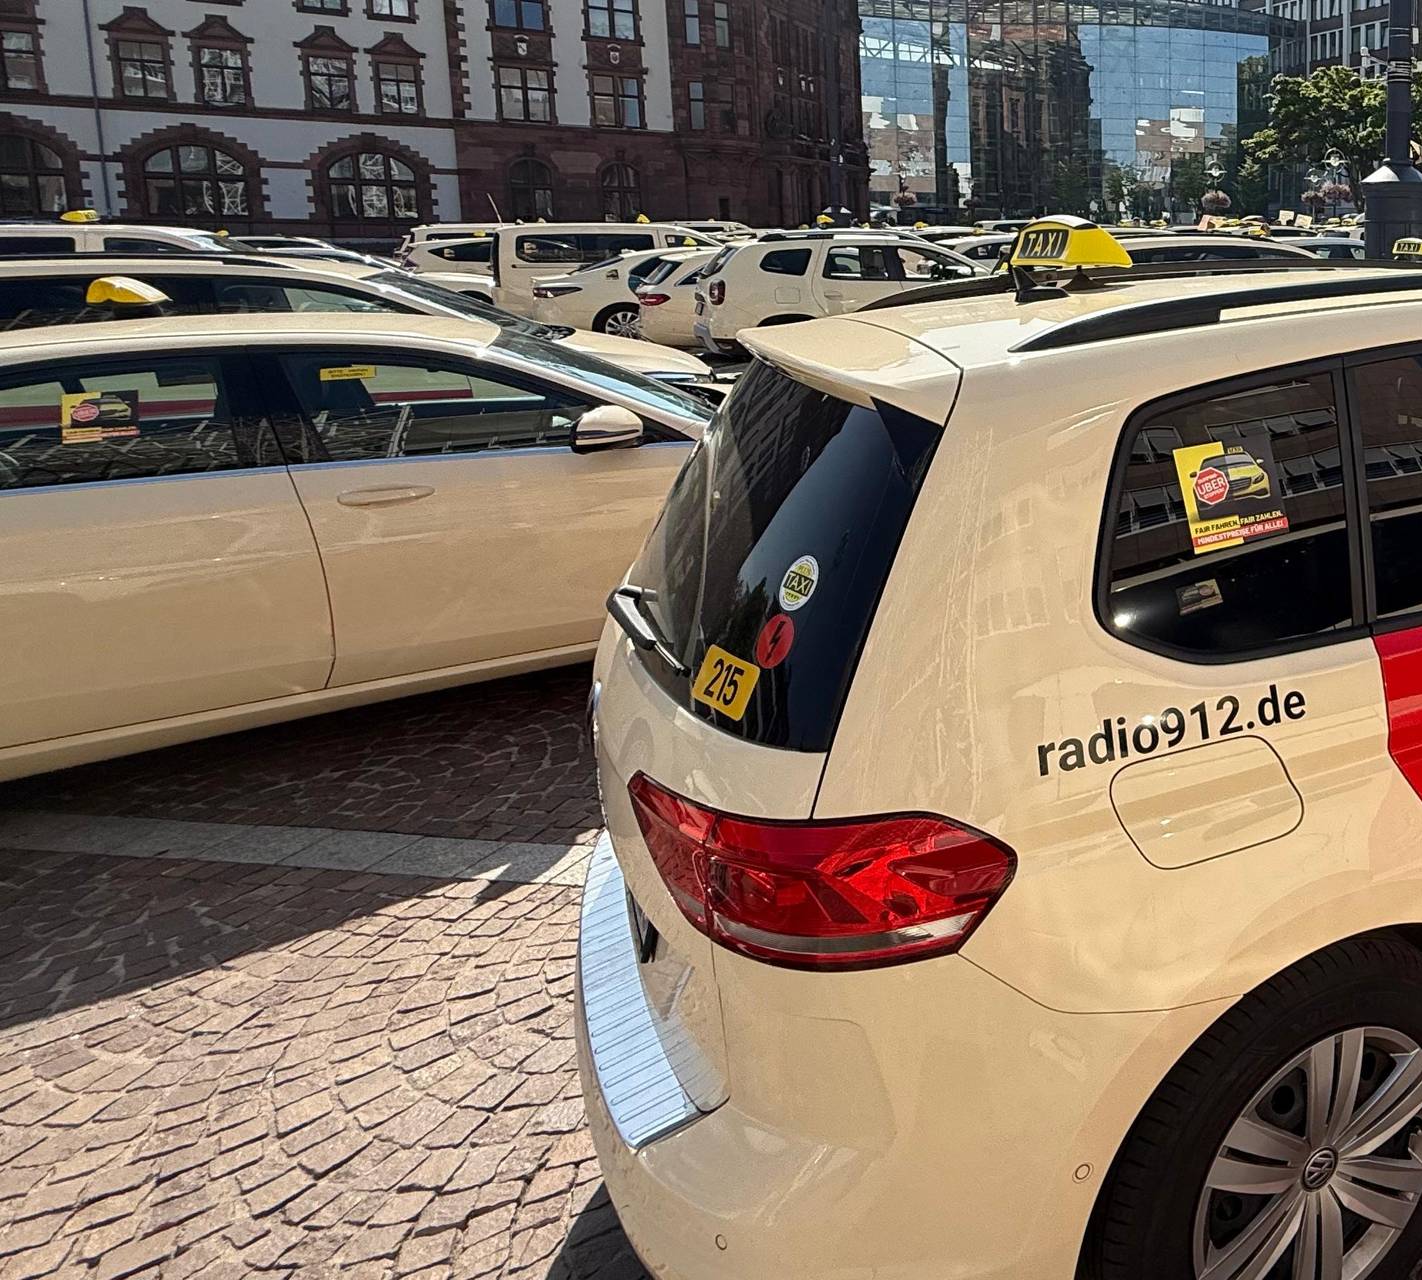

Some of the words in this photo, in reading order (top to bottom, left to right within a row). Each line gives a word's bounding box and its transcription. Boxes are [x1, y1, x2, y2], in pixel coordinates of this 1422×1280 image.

[1025, 232, 1063, 257] TAXI
[1400, 243, 1418, 252] TAXI
[1197, 477, 1227, 495] UBER
[1194, 525, 1211, 535] FAIR
[1211, 519, 1240, 532] FAHREN.
[1240, 515, 1255, 525] FAIR
[1255, 510, 1284, 522] ZAHLEN.
[1197, 528, 1250, 546] MINDESTPREISE
[1250, 524, 1264, 535] FÜR
[786, 573, 812, 595] TAXI
[703, 657, 745, 707] 215
[1037, 684, 1307, 777] radio912.de
